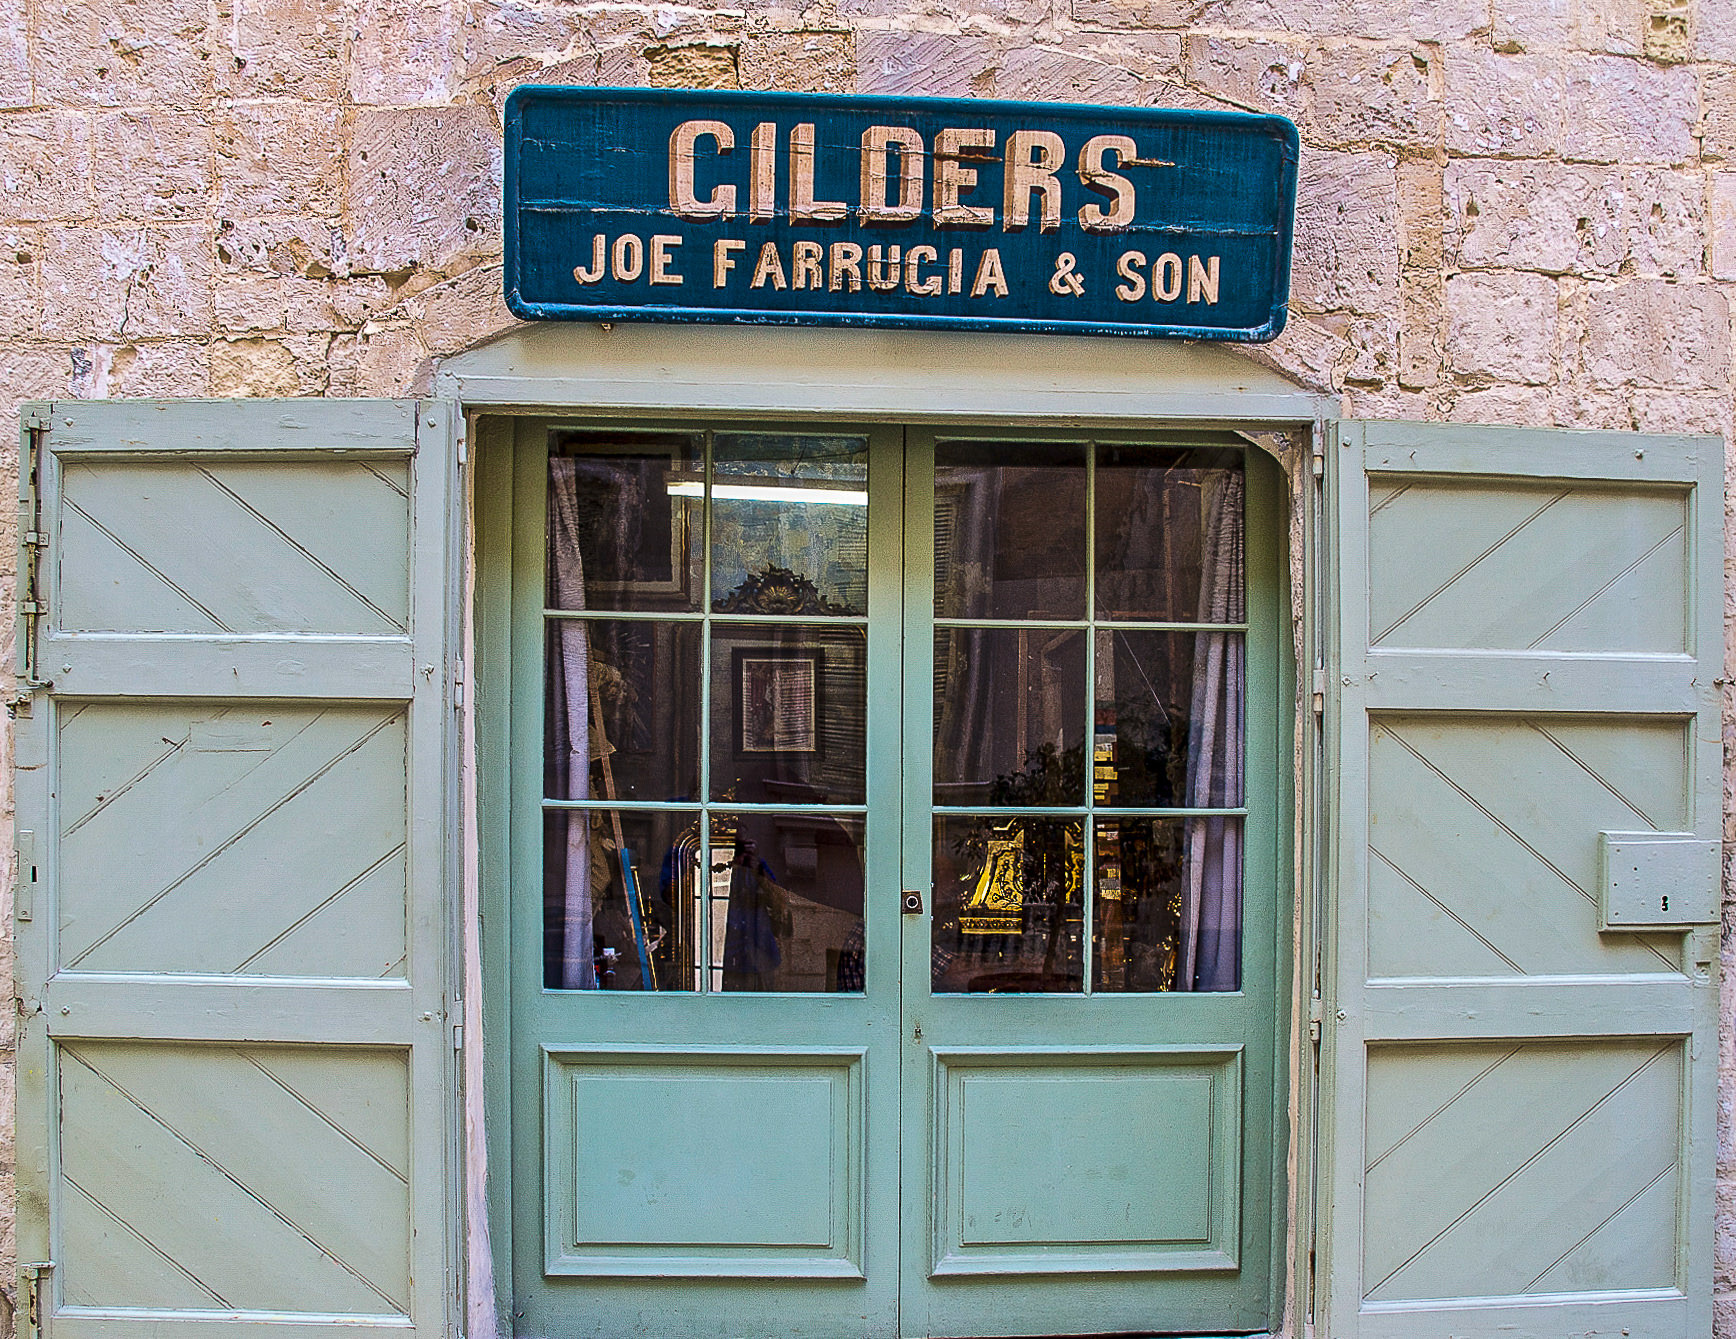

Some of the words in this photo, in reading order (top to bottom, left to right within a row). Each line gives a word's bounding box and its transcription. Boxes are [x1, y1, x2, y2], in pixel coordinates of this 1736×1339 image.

[669, 120, 1137, 234] GILDERS
[574, 233, 683, 285] JOE
[713, 239, 1009, 298] FARRUGIA
[1049, 252, 1085, 297] &
[1115, 250, 1220, 306] SON
